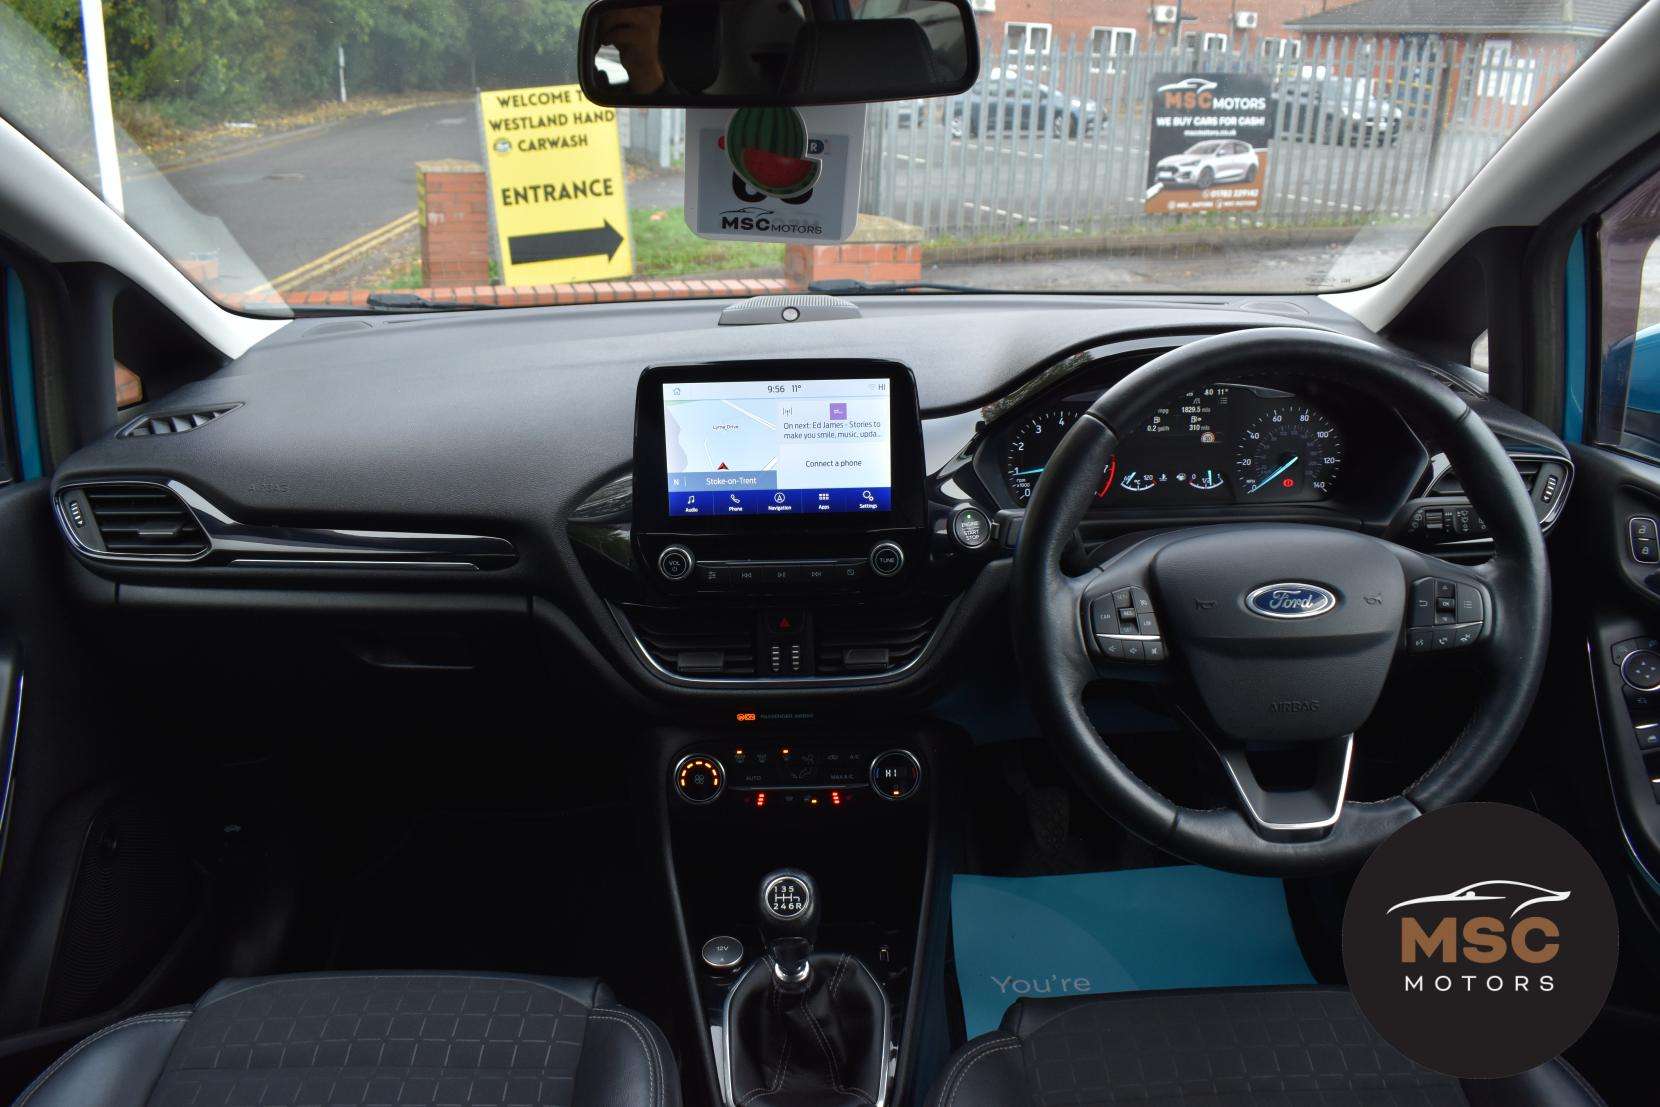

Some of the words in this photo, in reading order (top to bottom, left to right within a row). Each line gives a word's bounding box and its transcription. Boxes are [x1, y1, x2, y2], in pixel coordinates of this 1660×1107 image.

[497, 90, 571, 108] WELCOME
[1165, 91, 1212, 110] MSC
[1213, 97, 1266, 110] MOTORS
[489, 113, 568, 132] WESTLAND
[574, 110, 615, 125] HAND
[1156, 117, 1171, 126] WE
[1173, 117, 1192, 126] BUY
[1194, 117, 1218, 126] CARS
[1219, 117, 1237, 126] FOR
[518, 134, 588, 152] CARWASH
[501, 178, 614, 206] ENTRANCE
[721, 216, 770, 231] MSC
[771, 223, 823, 234] MOTORS
[768, 385, 785, 393] 9:56
[791, 384, 802, 392] 11°
[878, 383, 886, 391] HI
[1300, 414, 1310, 422] 80
[1035, 425, 1042, 434] 3
[817, 431, 836, 439] smile,
[1250, 432, 1259, 440] 40
[1018, 442, 1025, 451] 2
[840, 459, 862, 467] phone
[706, 477, 757, 486] Stoke-on-Trent
[1313, 481, 1325, 489] 140
[1024, 488, 1031, 497] 0
[1268, 590, 1314, 610] Ford
[1270, 700, 1320, 713] AIRBAG
[990, 974, 1092, 994] You're
